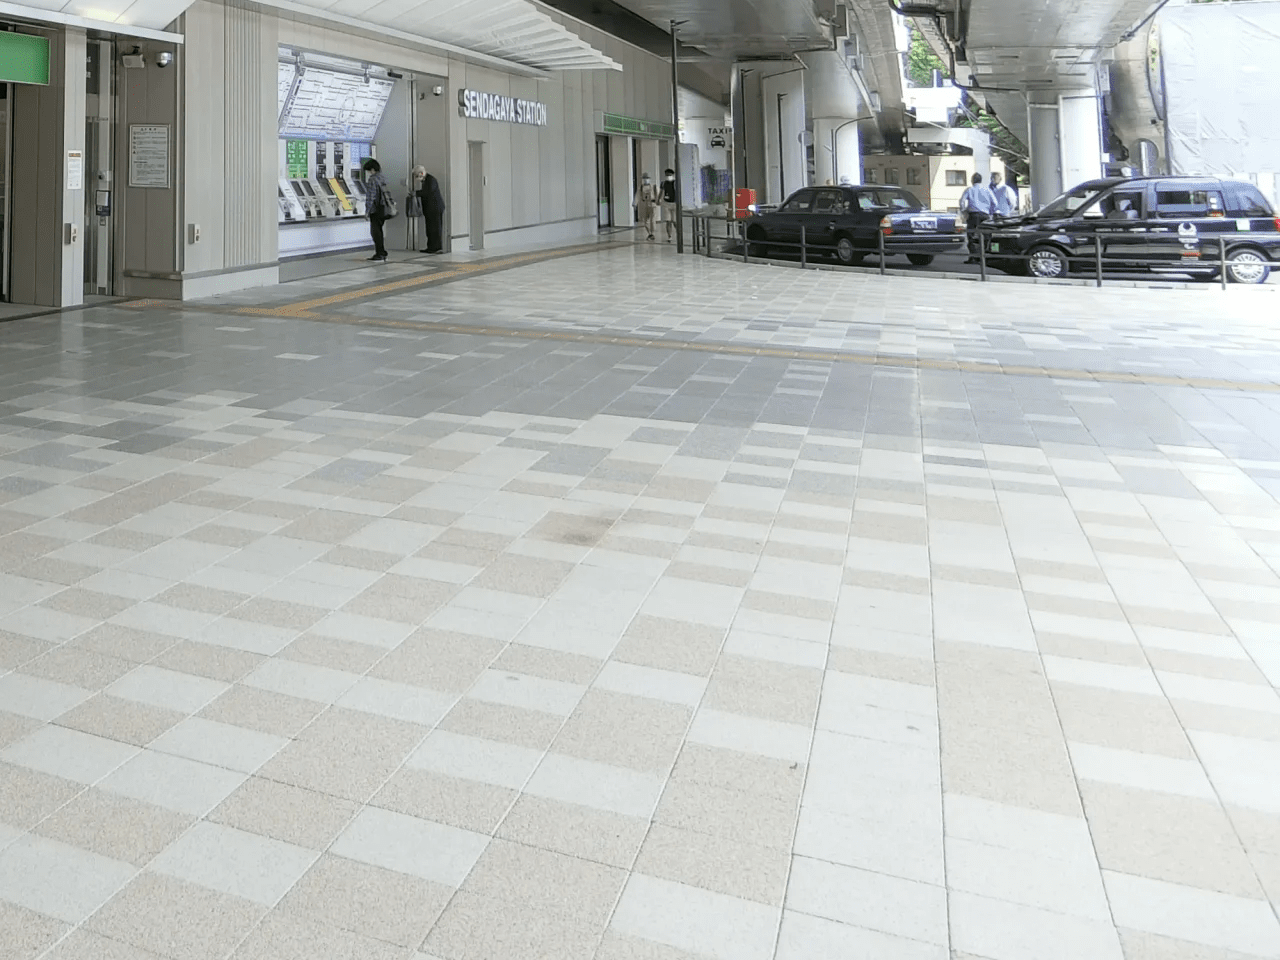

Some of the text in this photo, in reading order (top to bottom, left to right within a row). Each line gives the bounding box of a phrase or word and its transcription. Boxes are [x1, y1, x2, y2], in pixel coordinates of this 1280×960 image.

[462, 88, 547, 126] SENDAGAYA STATION
[707, 127, 728, 135] TAXI
